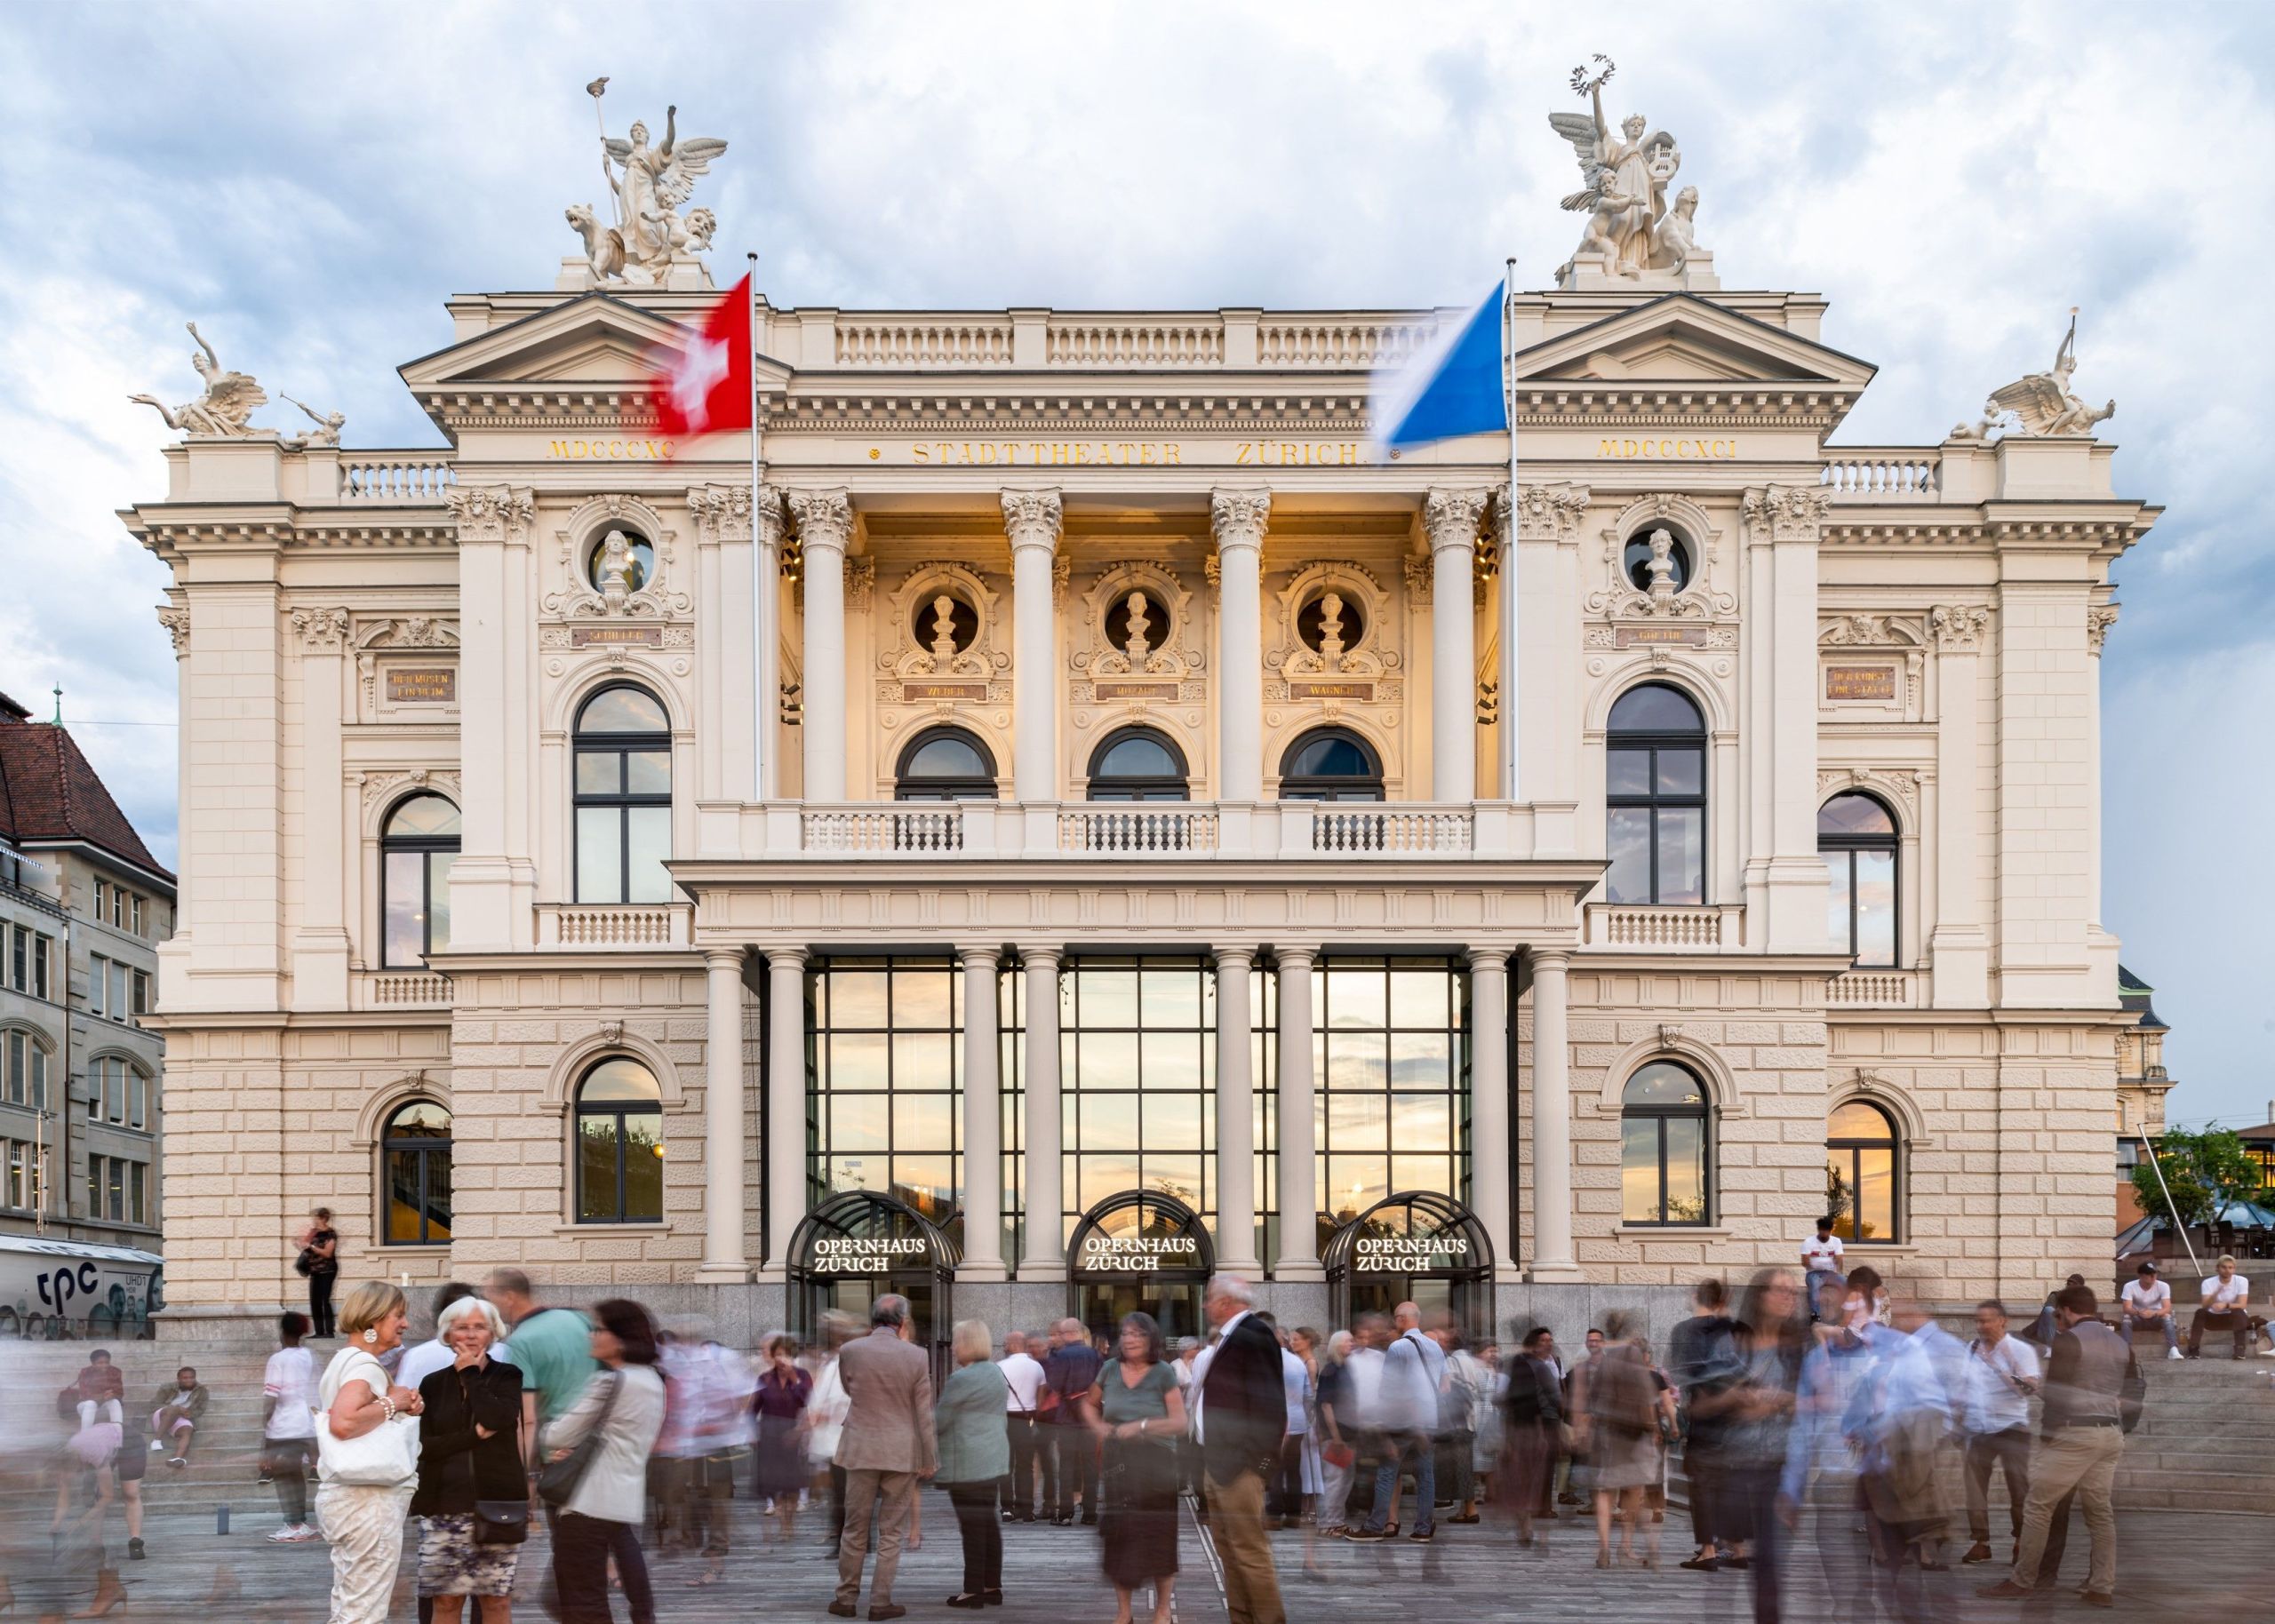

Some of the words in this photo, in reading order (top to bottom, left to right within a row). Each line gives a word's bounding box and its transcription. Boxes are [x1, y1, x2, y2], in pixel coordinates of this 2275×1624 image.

[1236, 439, 1357, 466] ZÜRICH
[1596, 440, 1736, 458] MDCCCXCI
[814, 1238, 926, 1254] OPERNHAUS
[1085, 1238, 1196, 1253] OPERNHAUS
[1356, 1238, 1467, 1254] OPERNHAUS
[814, 1254, 889, 1272] ZÜRICH
[1085, 1253, 1160, 1271] ZÜRICH
[1356, 1254, 1431, 1271] ZÜRICH
